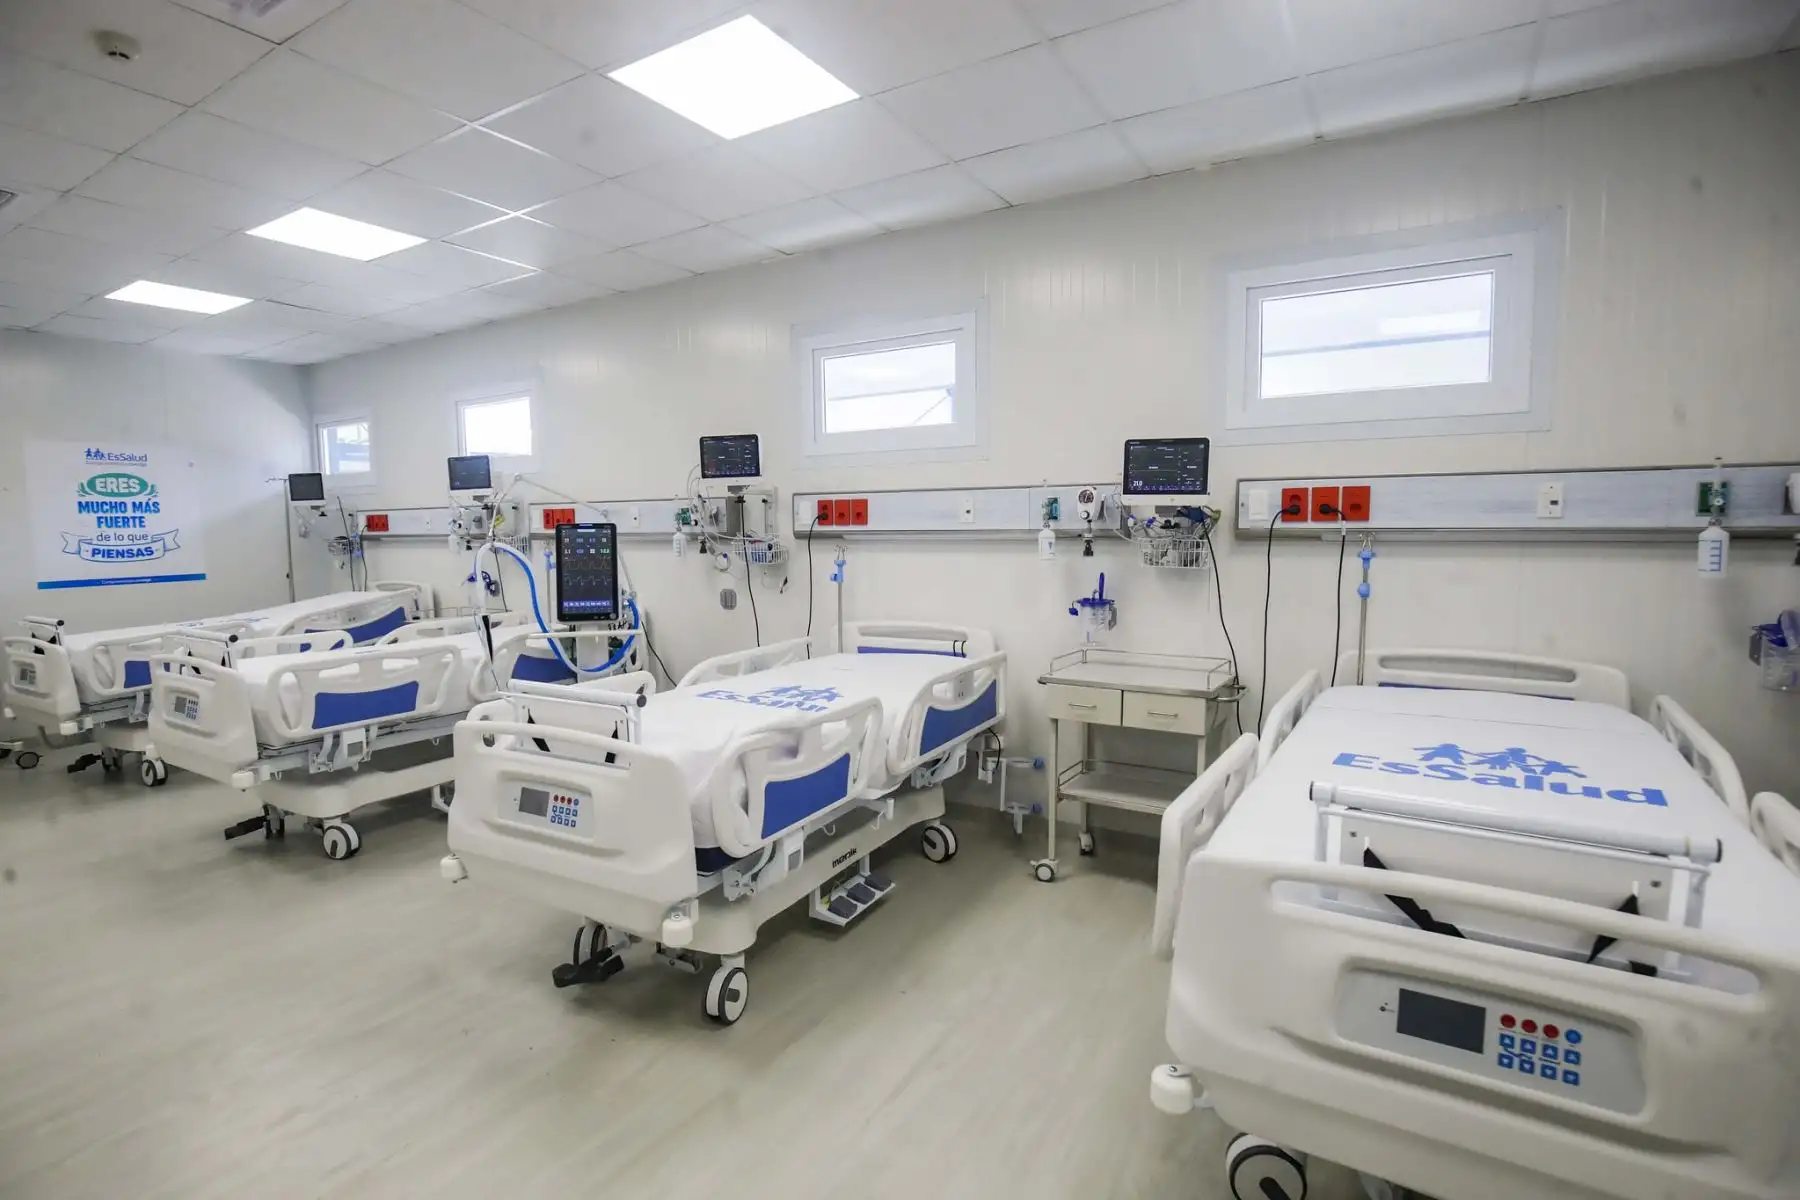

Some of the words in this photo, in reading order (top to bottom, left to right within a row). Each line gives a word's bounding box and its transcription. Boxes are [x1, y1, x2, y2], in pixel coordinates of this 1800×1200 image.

[107, 452, 148, 462] EsSalud
[95, 477, 141, 493] ERES
[77, 501, 128, 514] MUCHO
[132, 498, 160, 514] MÁS
[96, 516, 146, 529] FUERTE
[96, 532, 111, 542] de
[113, 532, 125, 541] lo
[128, 533, 149, 543] que
[91, 546, 155, 559] PIENSAS
[1332, 752, 1669, 807] EsSalud
